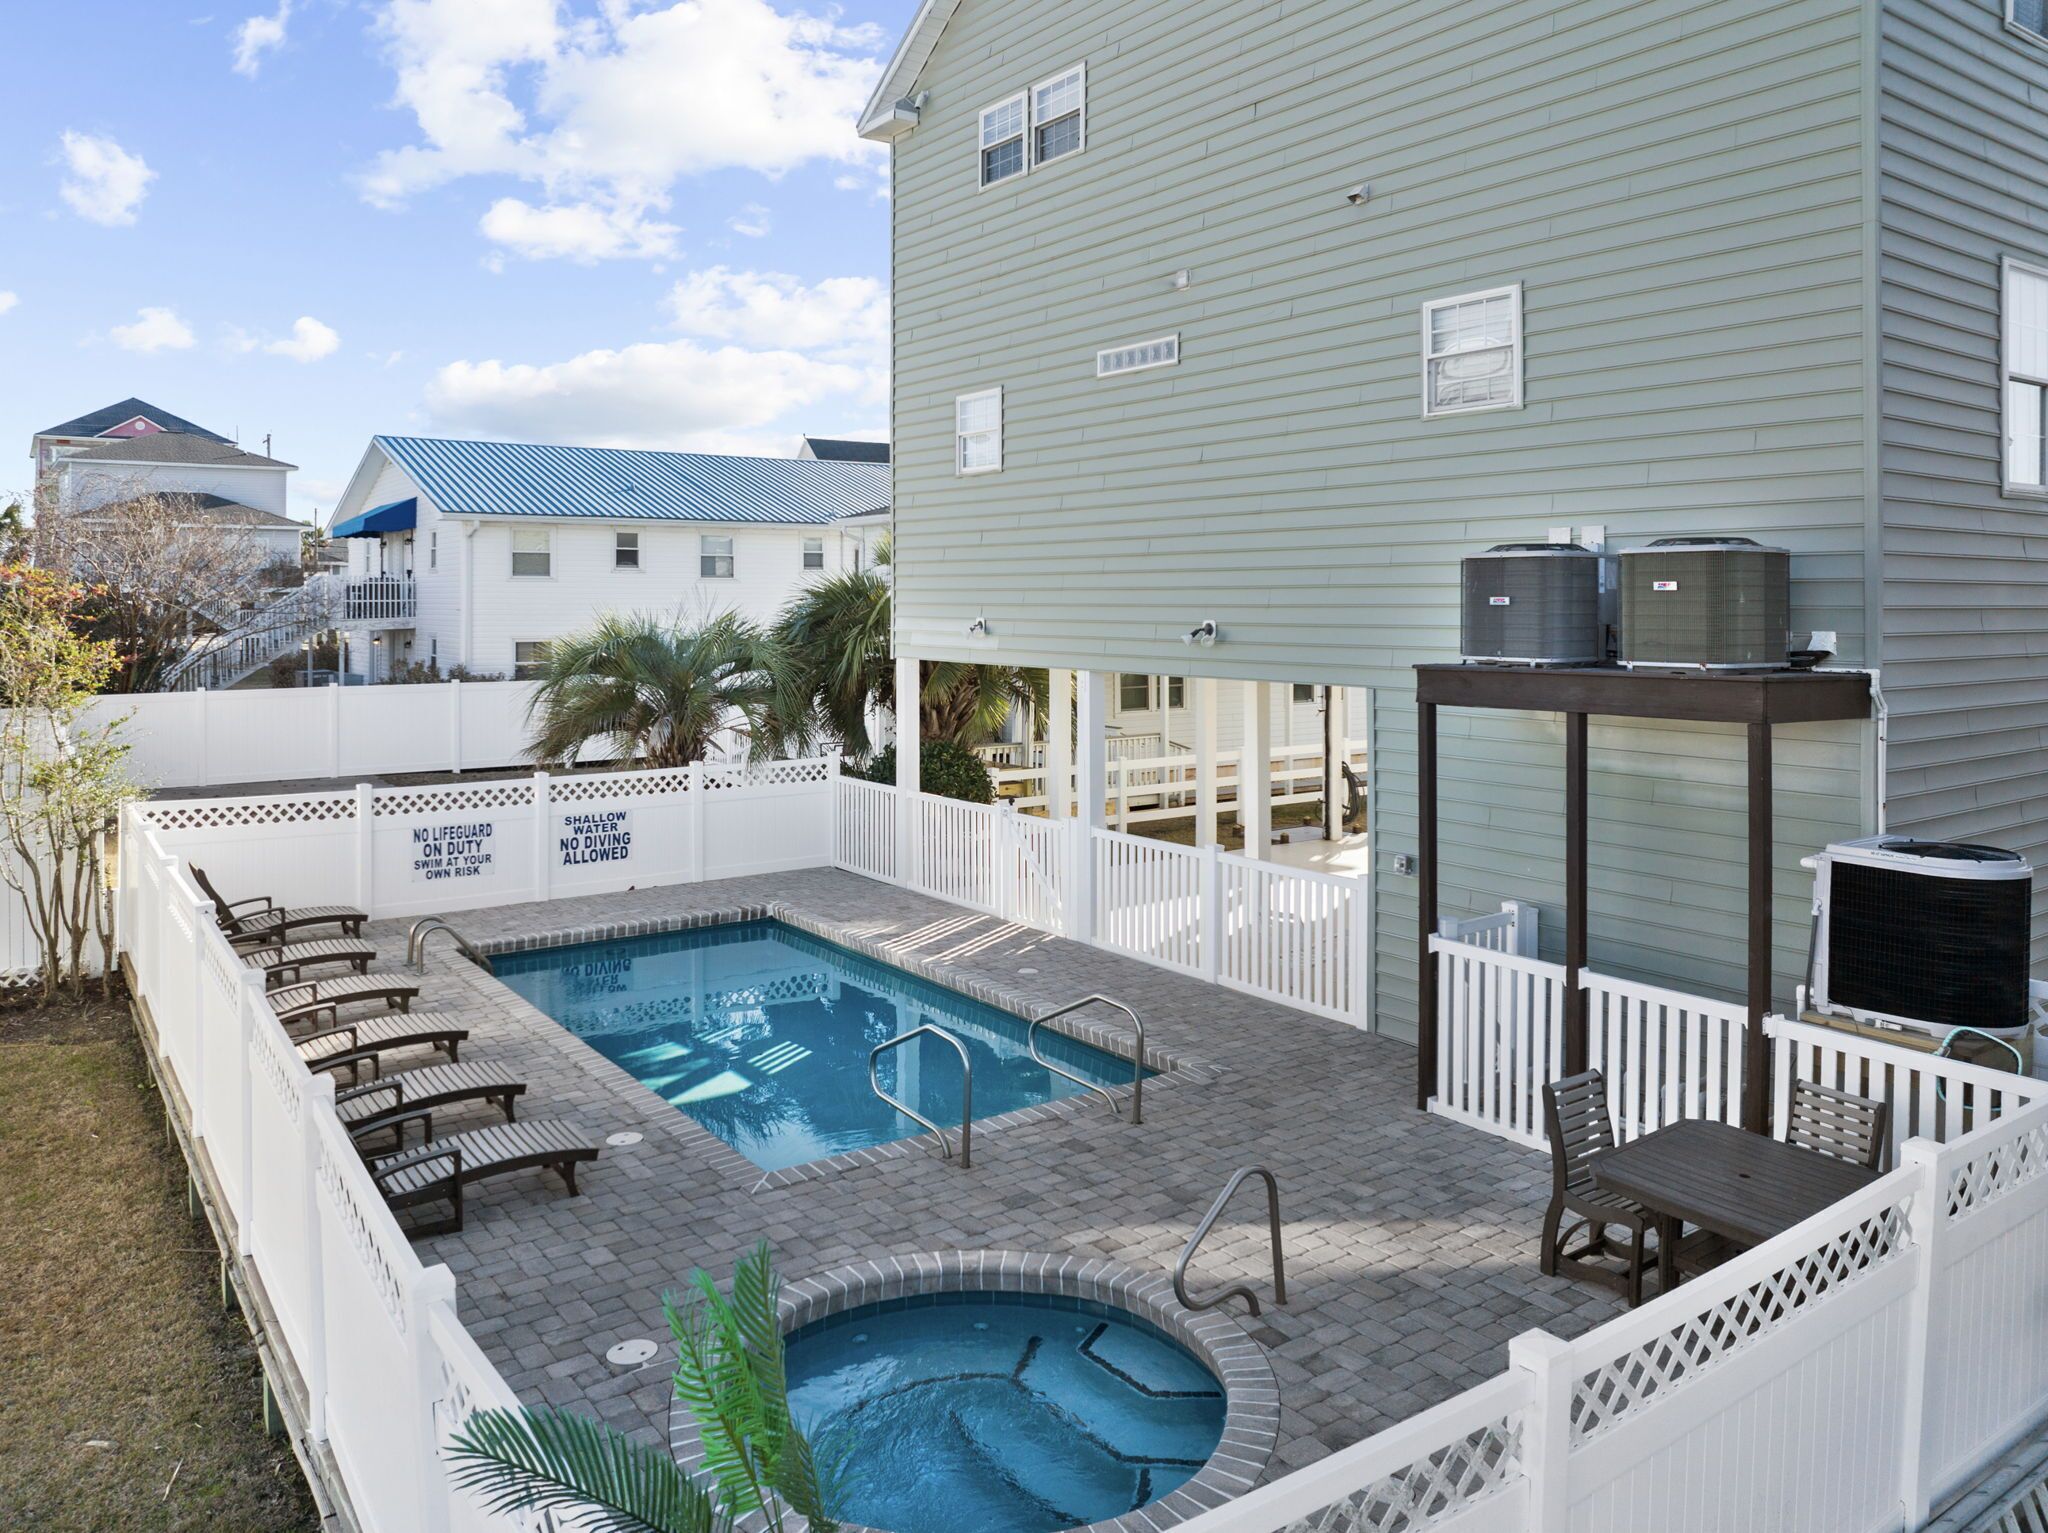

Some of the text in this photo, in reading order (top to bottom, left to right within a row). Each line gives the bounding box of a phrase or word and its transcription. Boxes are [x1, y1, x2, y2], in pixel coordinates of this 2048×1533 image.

[564, 811, 626, 826] SHALLOW
[413, 823, 492, 843] NO LIFEGUARD
[573, 822, 618, 835] WATER
[423, 839, 483, 857] ON DUTY
[560, 832, 631, 851] NO DIVING
[414, 854, 492, 870] SWIM AT YOUR
[563, 846, 629, 865] ALLOWED
[425, 866, 480, 879] OWN RISK
